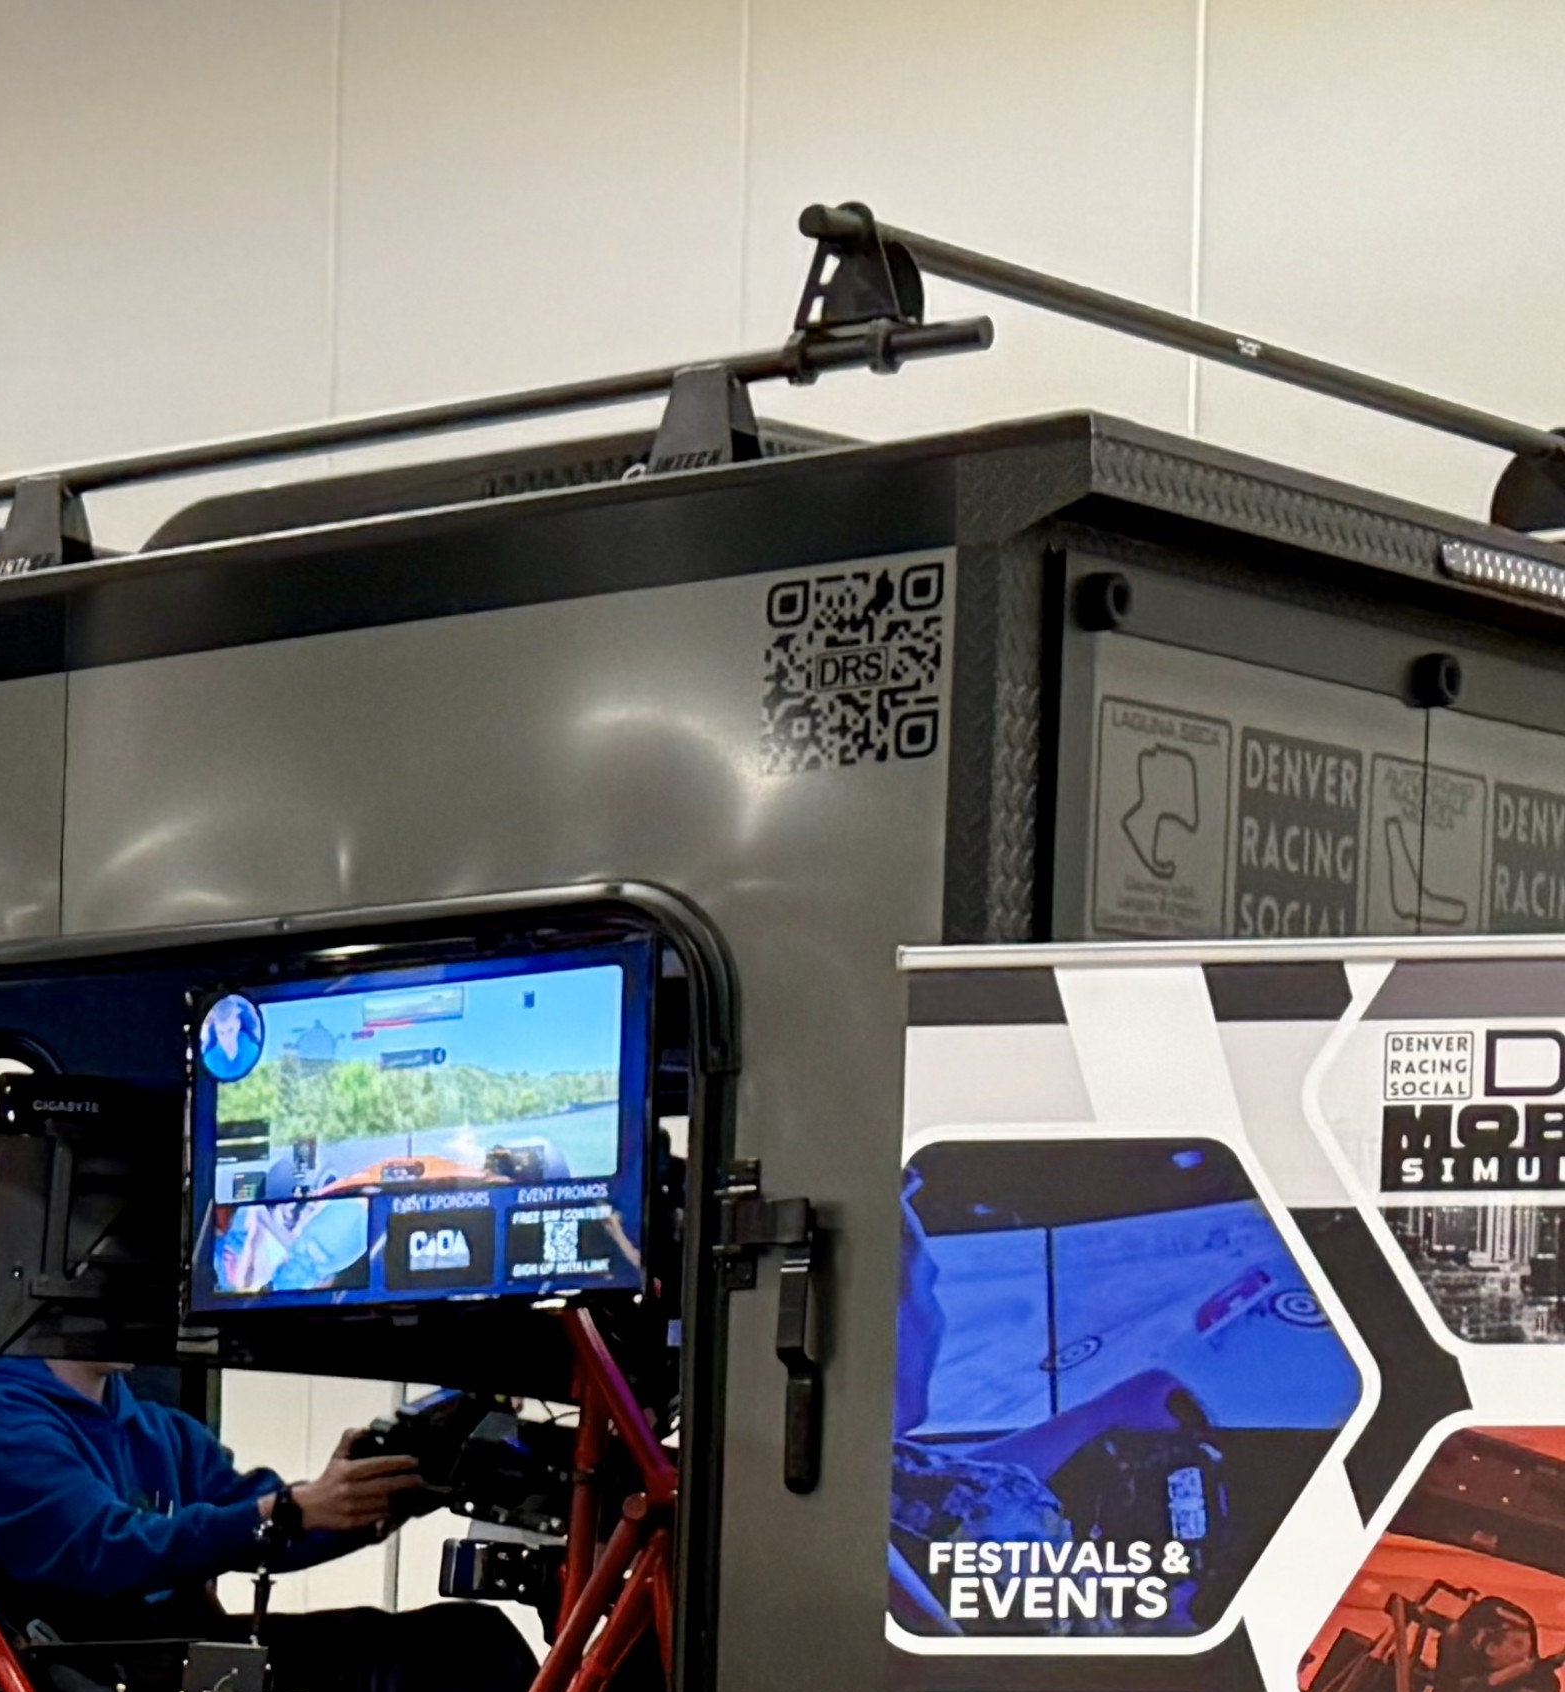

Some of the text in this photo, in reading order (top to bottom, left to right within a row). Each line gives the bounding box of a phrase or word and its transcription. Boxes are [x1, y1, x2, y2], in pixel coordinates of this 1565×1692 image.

[820, 652, 883, 687] DRS
[1245, 738, 1358, 809] DENVER
[1241, 816, 1355, 884] RACING
[1239, 893, 1348, 937] SOCIAL
[1391, 1037, 1468, 1052] DENVER
[1390, 1058, 1467, 1074] RACING
[1390, 1081, 1467, 1096] SOCIAL
[392, 1191, 490, 1213] EVENT SPONSORS
[517, 1183, 608, 1204] EVENT PROMOS
[929, 1541, 1191, 1575] FESTIVALS &
[949, 1577, 1168, 1619] EVENTS
